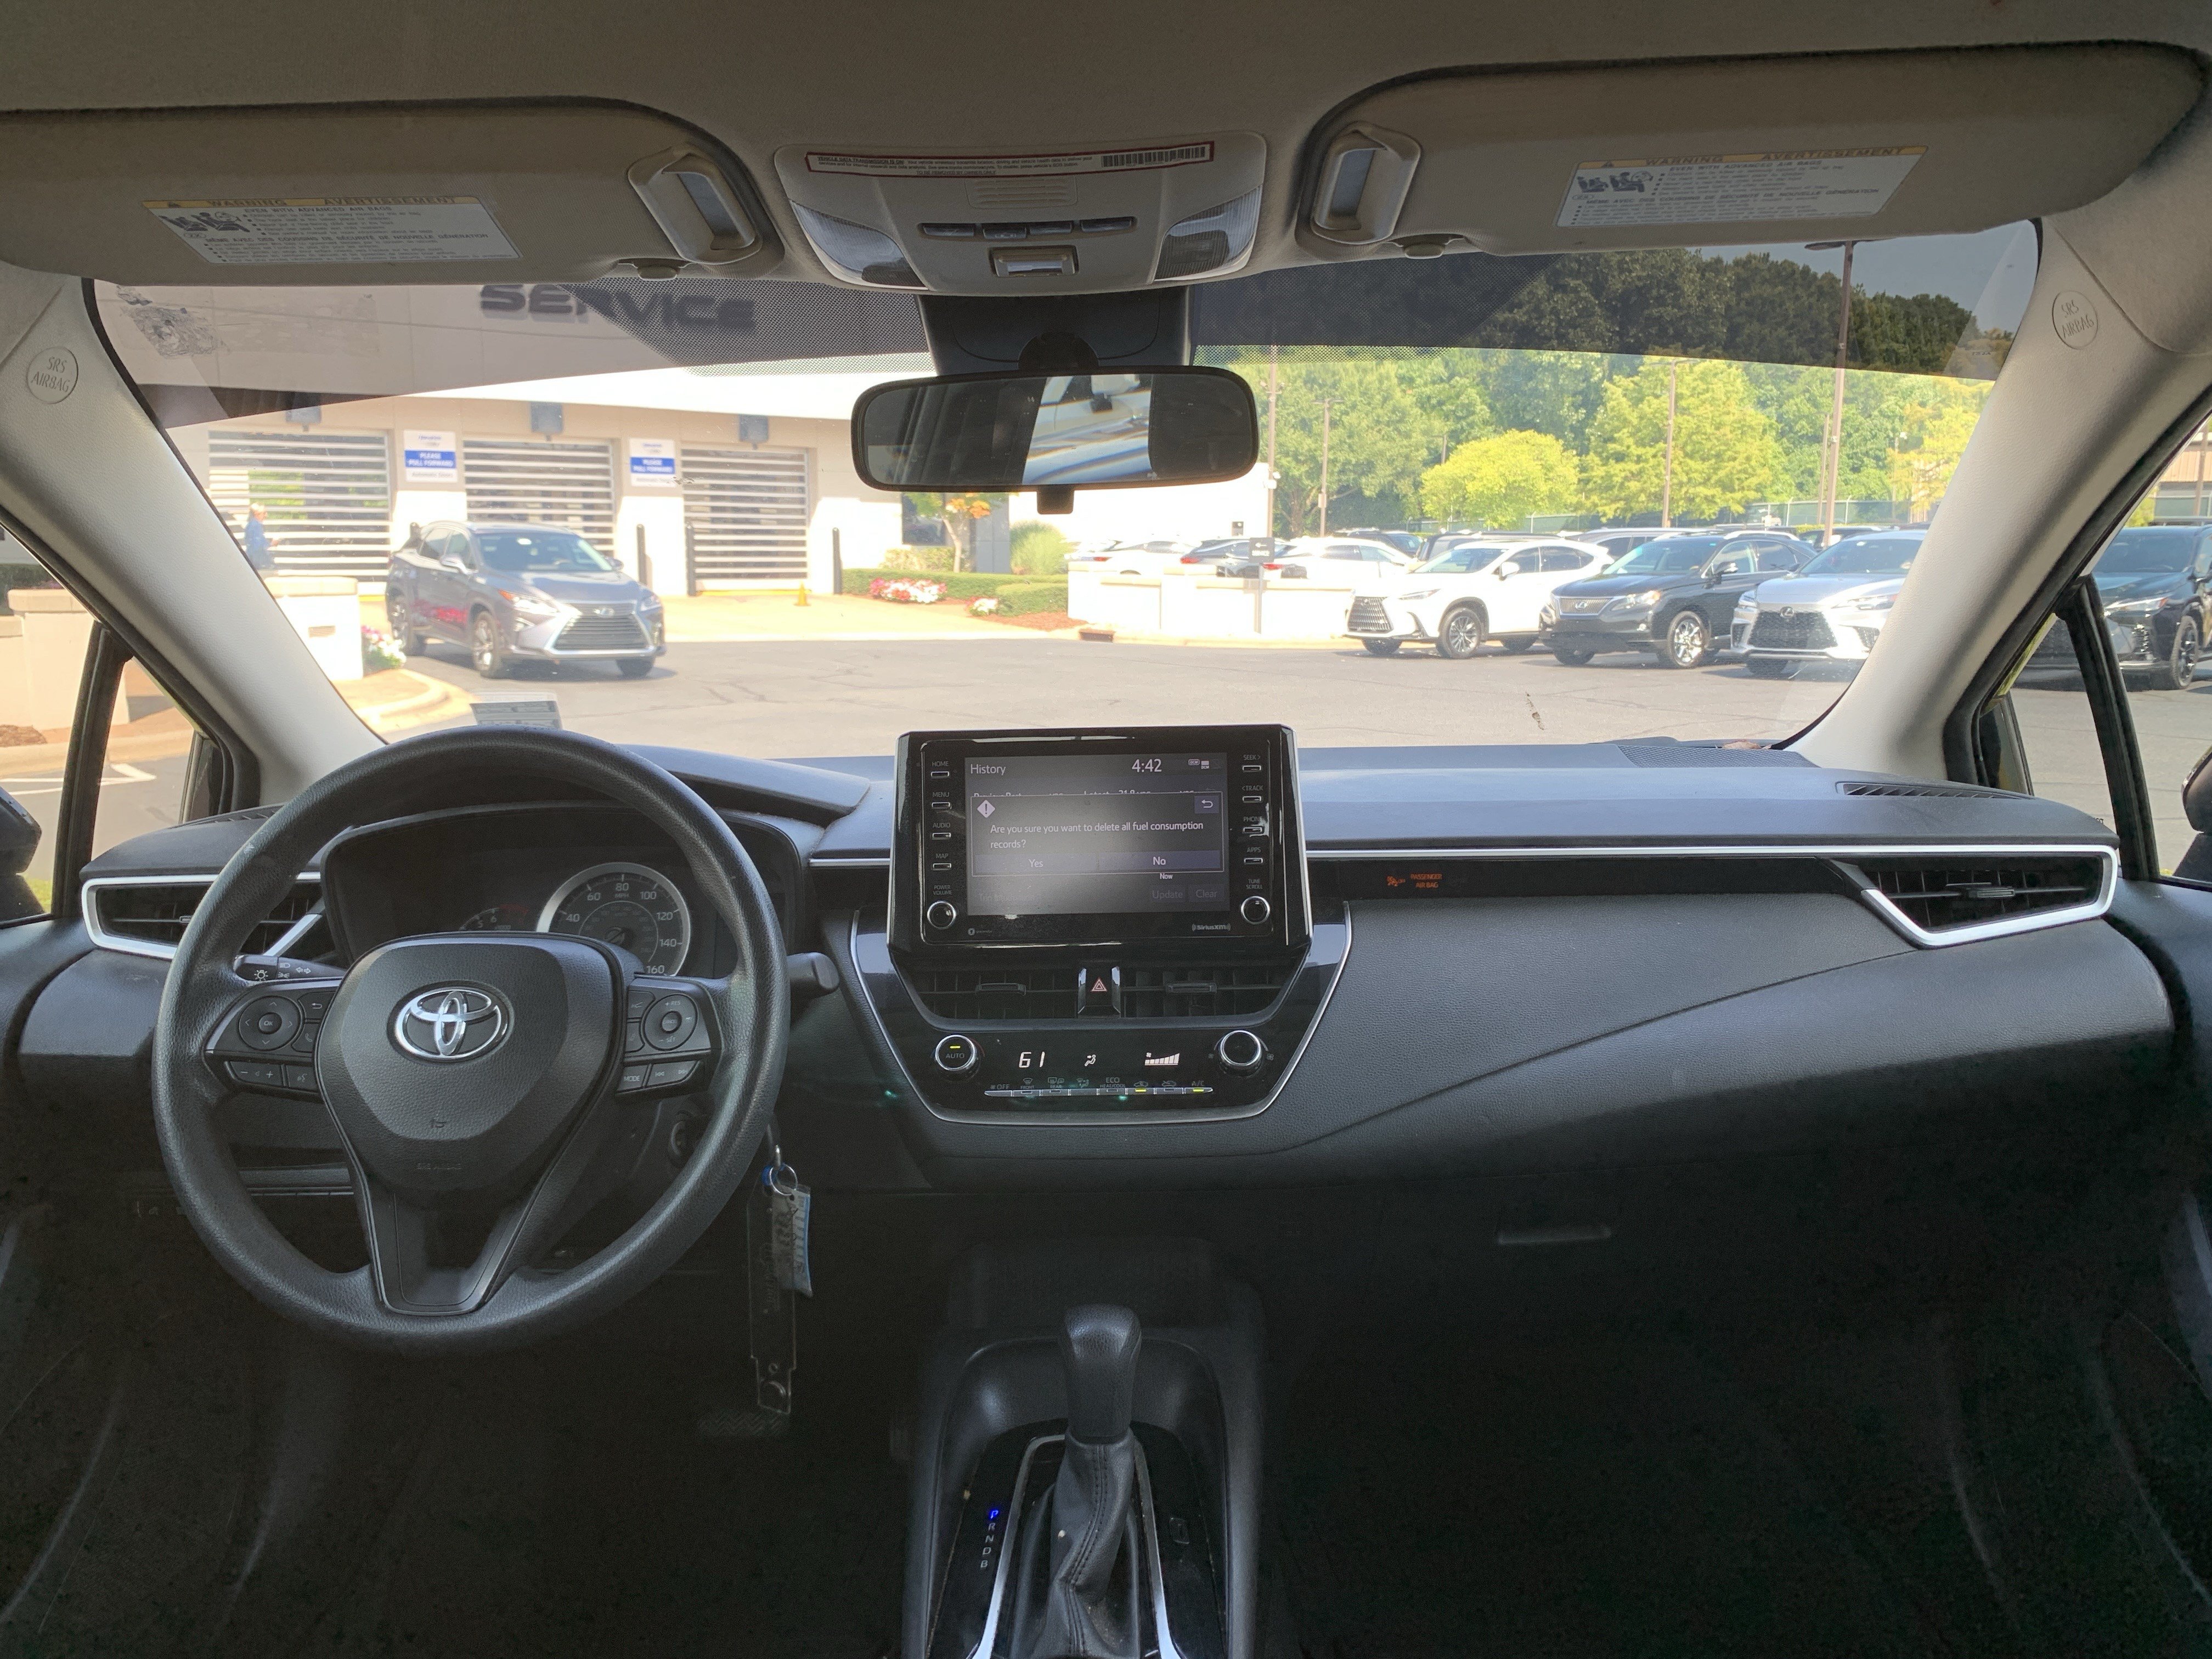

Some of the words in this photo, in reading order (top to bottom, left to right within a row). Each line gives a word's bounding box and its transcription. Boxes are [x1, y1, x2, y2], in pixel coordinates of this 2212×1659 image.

[2061, 299, 2079, 318] SRS
[2062, 314, 2095, 339] AIRBAG
[47, 356, 67, 374] SRS
[31, 371, 70, 393] AIRBAG
[970, 763, 1006, 776] History
[1132, 758, 1162, 772] 4:42
[990, 825, 1005, 833] Are
[1007, 826, 1022, 835] you
[1043, 825, 1059, 834] you
[1094, 822, 1120, 831] delete
[1121, 822, 1131, 831] all
[1132, 821, 1148, 831] fuel
[1150, 821, 1204, 832] consumption
[990, 839, 1026, 849] records?
[1029, 859, 1043, 867] Yes
[1153, 856, 1166, 865] No
[615, 883, 629, 891] 80
[587, 892, 601, 901] 60
[640, 891, 657, 900] 100
[1152, 890, 1183, 900] Update
[1195, 889, 1217, 898] Clear
[490, 915, 497, 923] 6
[566, 913, 580, 923] 40
[657, 911, 673, 921] 120
[477, 920, 483, 928] 5
[659, 938, 676, 947] 140
[646, 965, 665, 974] 160
[1019, 1051, 1045, 1068] 61
[990, 1510, 999, 1519] P
[988, 1522, 996, 1531] R
[985, 1534, 994, 1543] N
[983, 1547, 991, 1555] D
[980, 1560, 988, 1568] B
